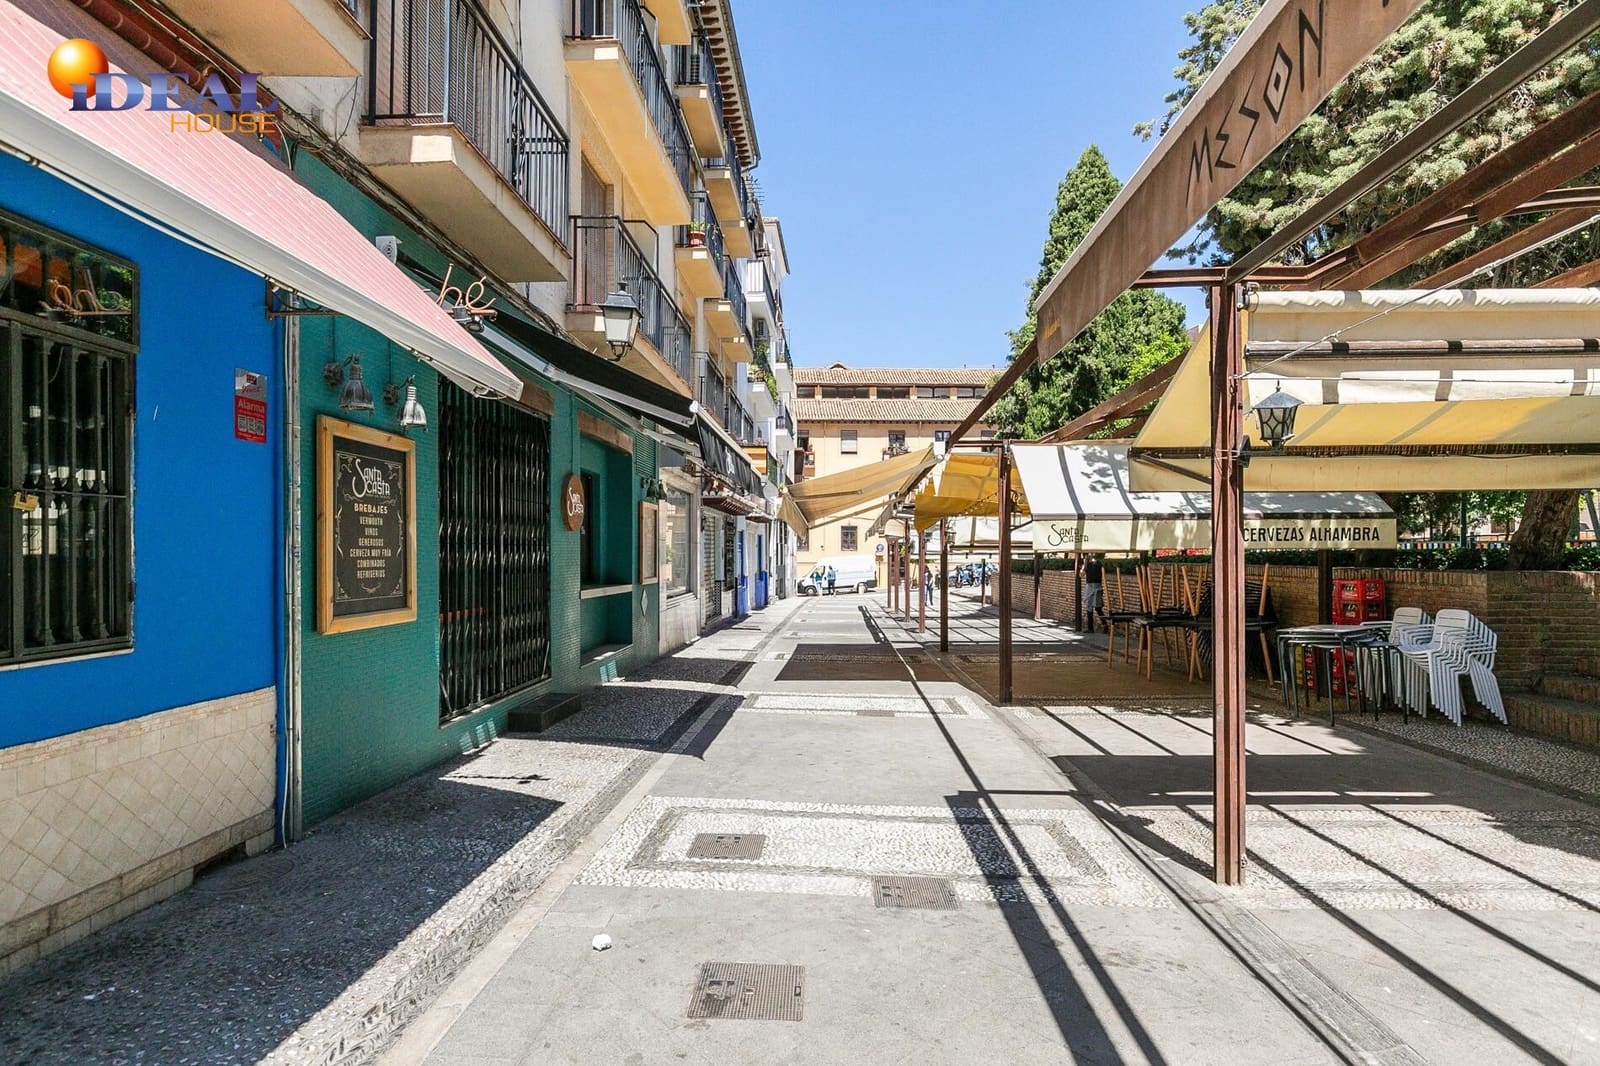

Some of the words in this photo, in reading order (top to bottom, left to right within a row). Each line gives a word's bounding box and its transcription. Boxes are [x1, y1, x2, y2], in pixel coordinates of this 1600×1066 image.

[238, 399, 265, 414] Alarma
[354, 503, 388, 514] BREBAJES
[365, 527, 378, 536] VINOS
[1243, 527, 1304, 542] CERVEZAS
[1309, 527, 1380, 541] ALHAMBRA
[350, 548, 370, 557] CERVEZA
[371, 549, 380, 557] MUY
